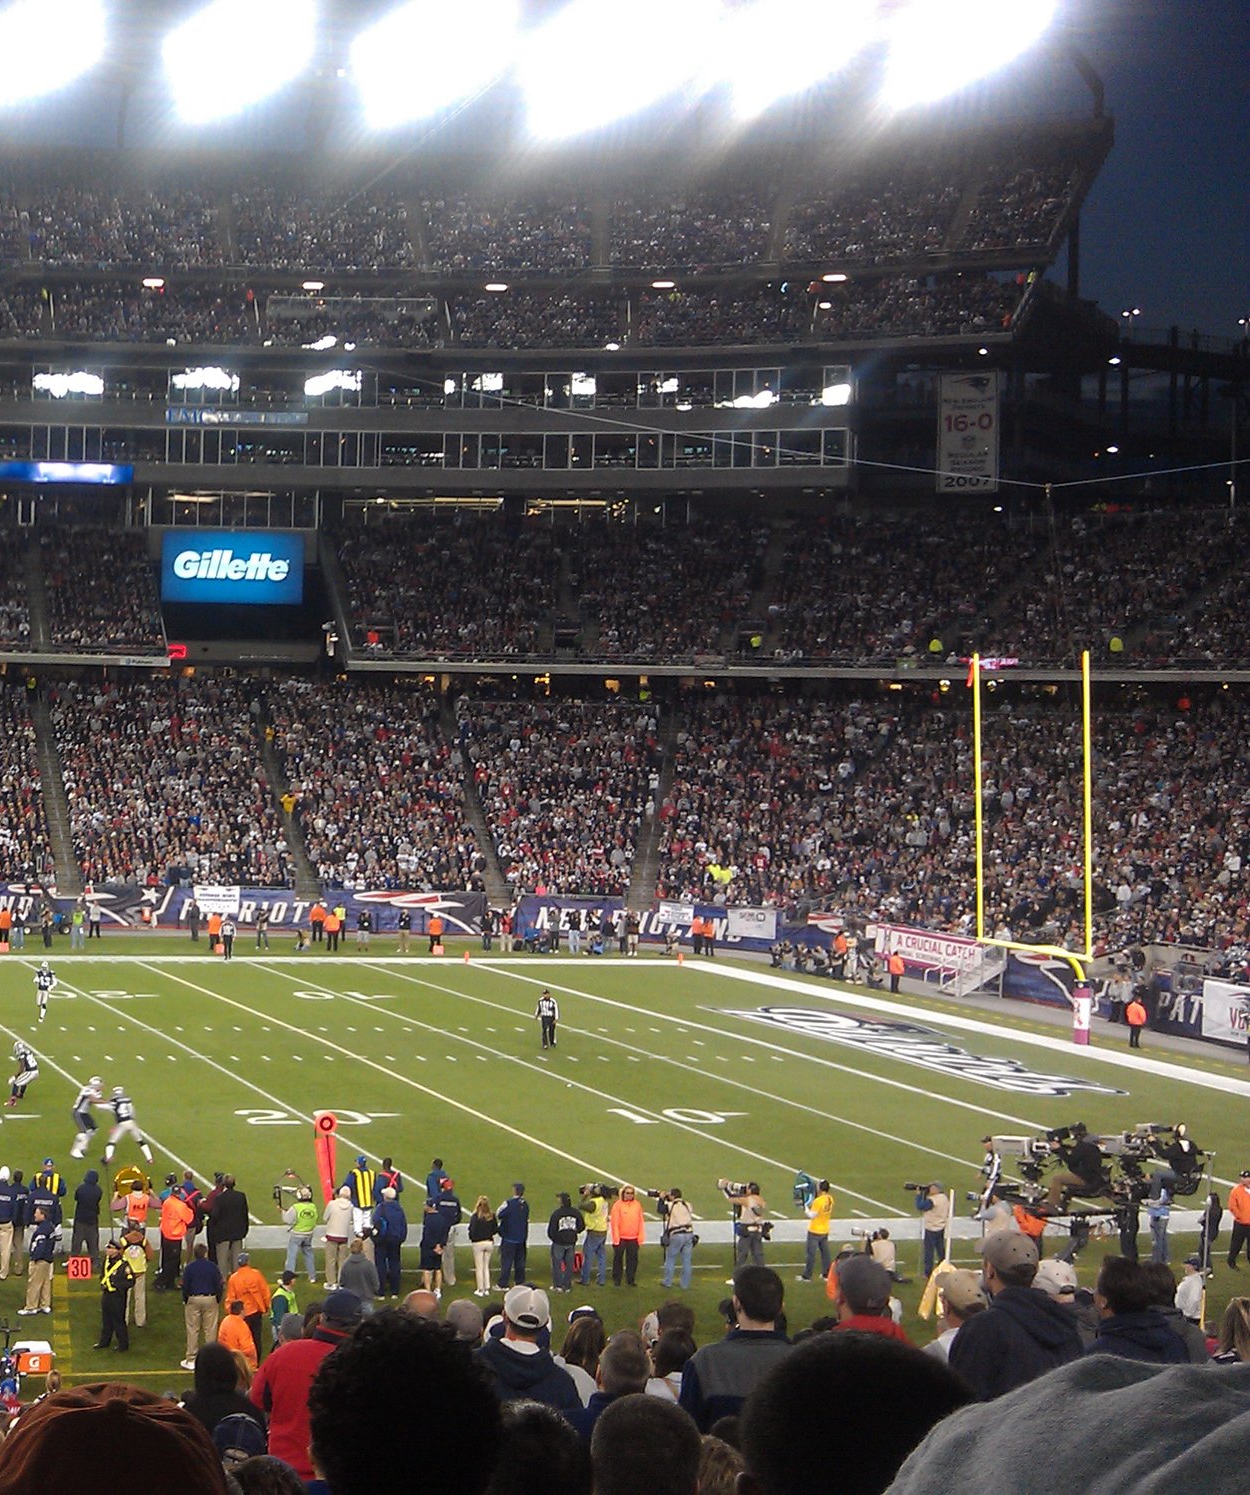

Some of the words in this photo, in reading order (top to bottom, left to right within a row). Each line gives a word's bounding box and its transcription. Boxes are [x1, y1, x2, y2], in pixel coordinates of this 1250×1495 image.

[945, 413, 993, 432] 16-0
[174, 550, 290, 581] Gillette
[897, 935, 903, 946] A
[905, 937, 943, 955] CRUCIAL
[71, 1259, 89, 1277] 30
